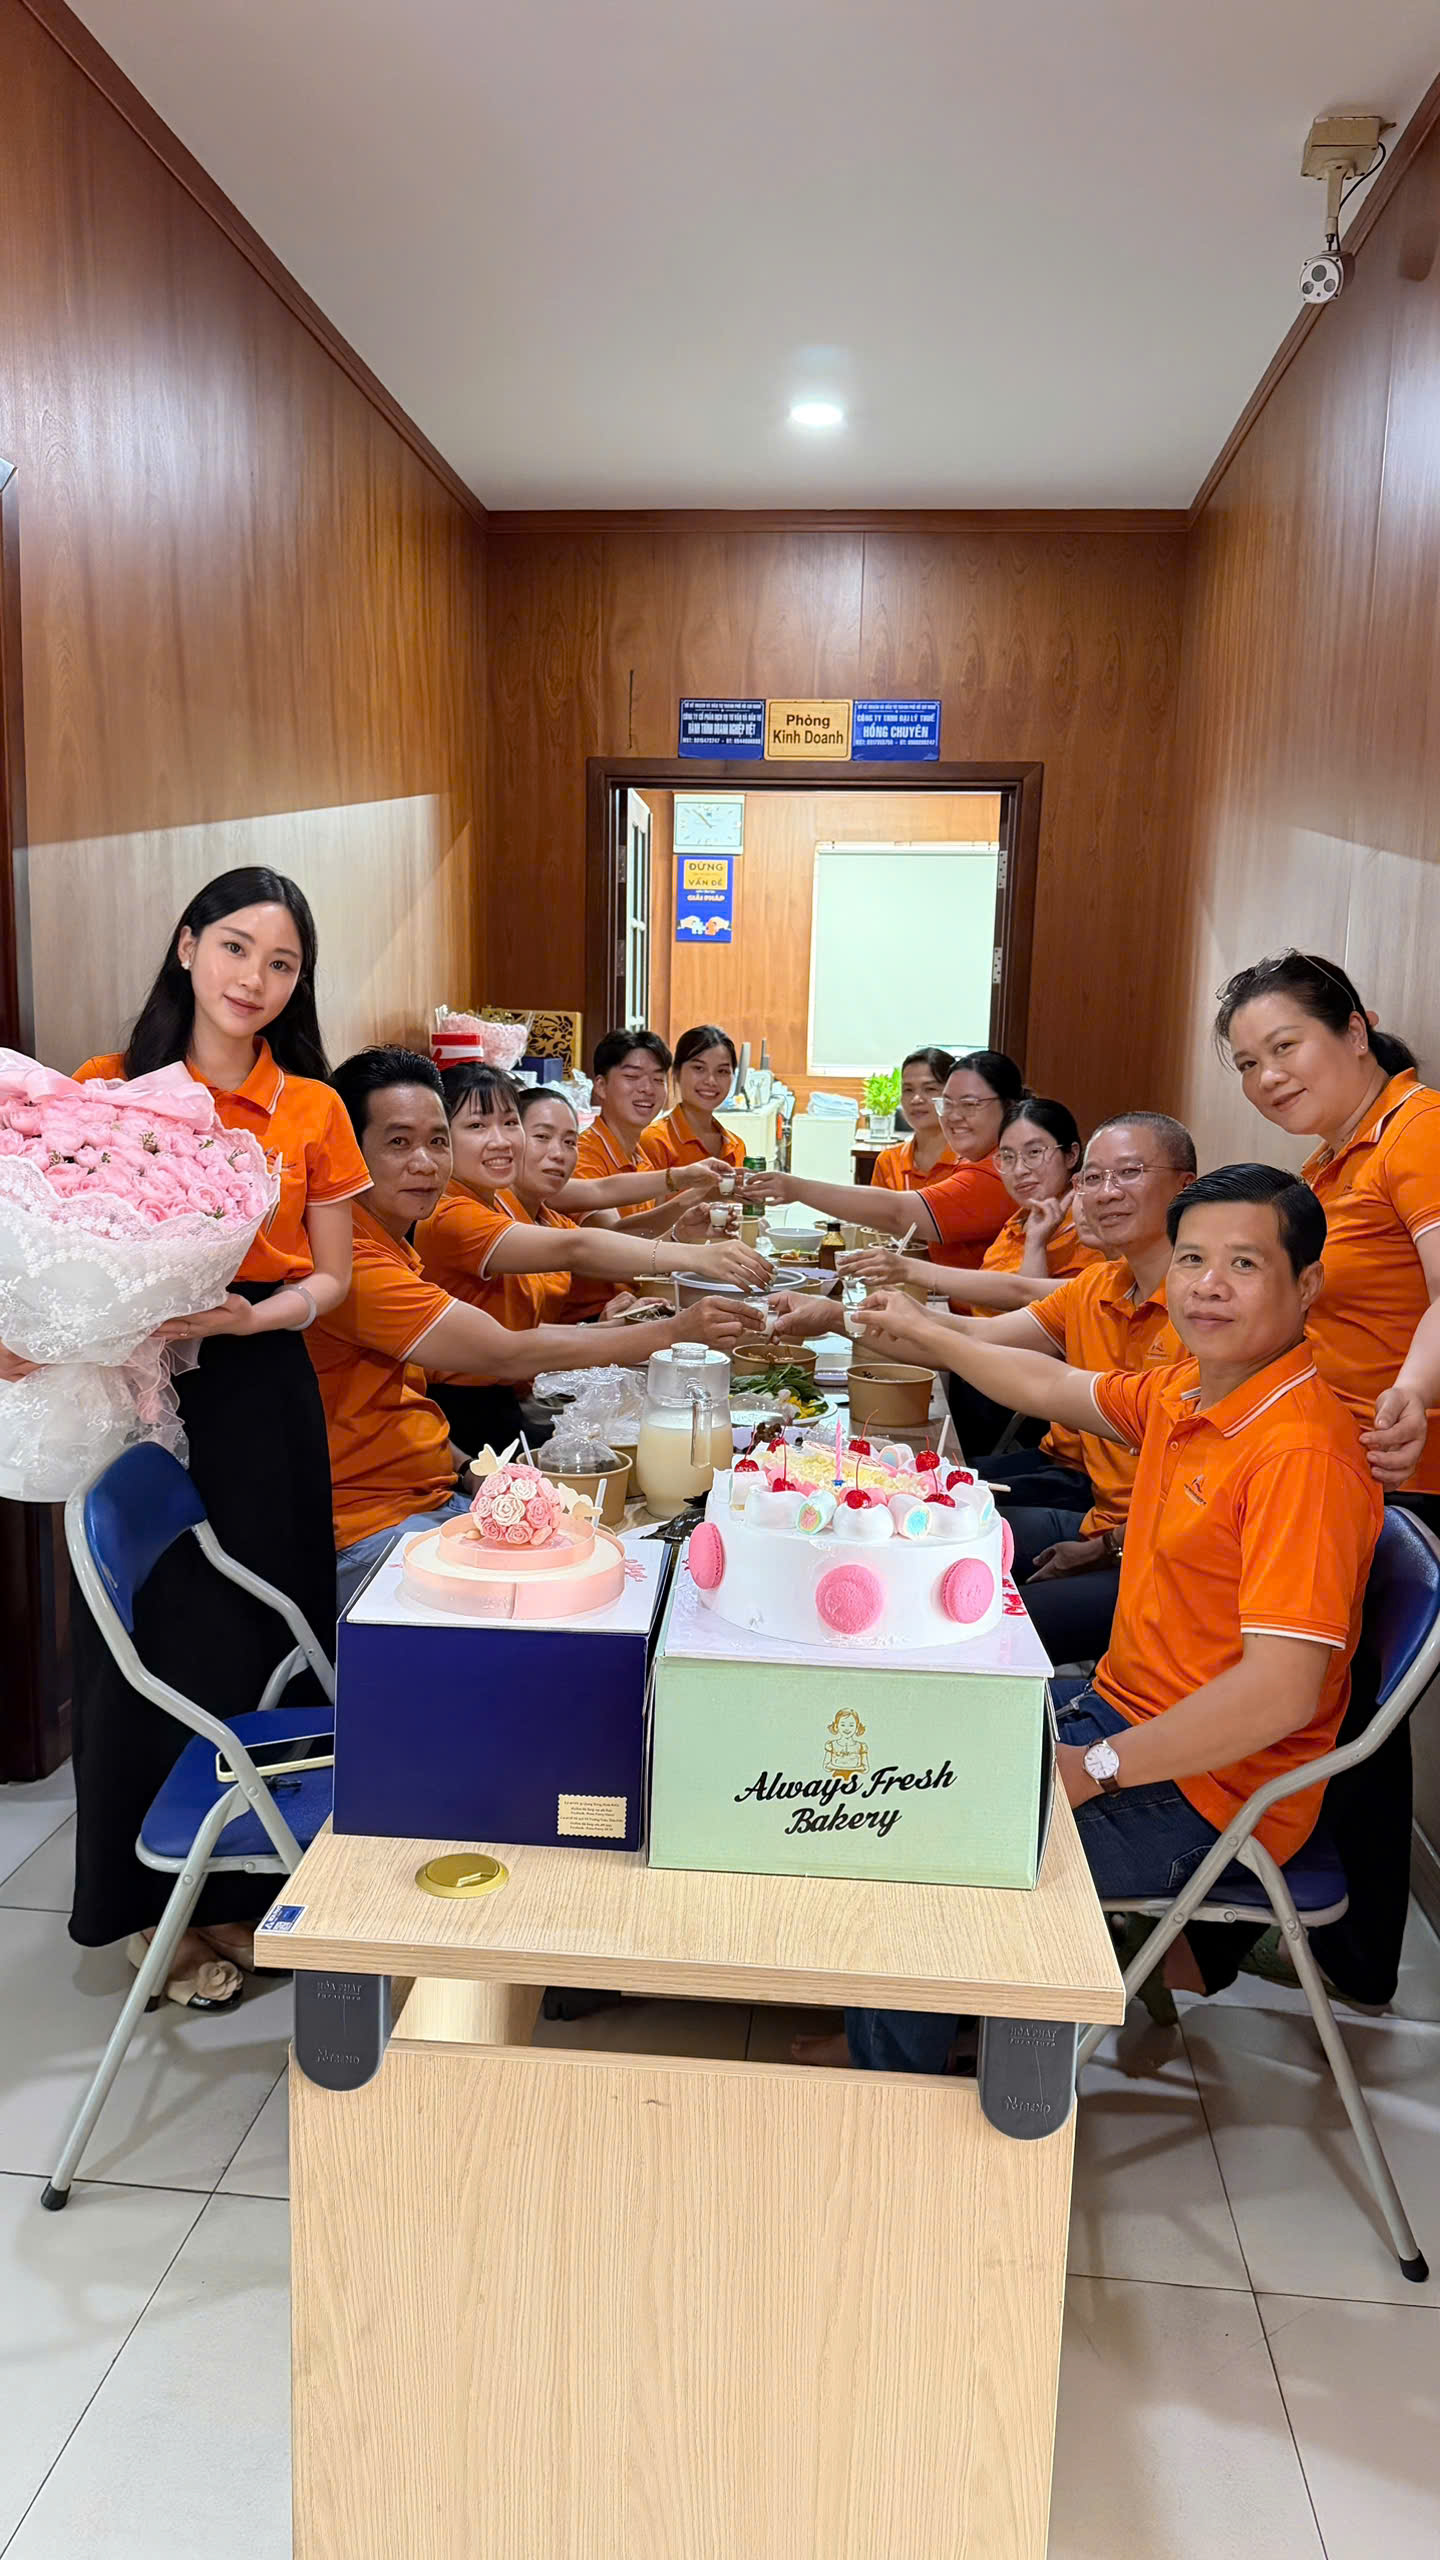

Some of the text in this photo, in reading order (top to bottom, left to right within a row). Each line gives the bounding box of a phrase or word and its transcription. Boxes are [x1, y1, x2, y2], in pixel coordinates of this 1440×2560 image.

[773, 730, 800, 744] Kinh
[805, 730, 844, 744] Doanh
[890, 724, 929, 738] CHUYÊN
[734, 1760, 958, 1806] Always Fresh
[784, 1803, 903, 1838] Bakery
